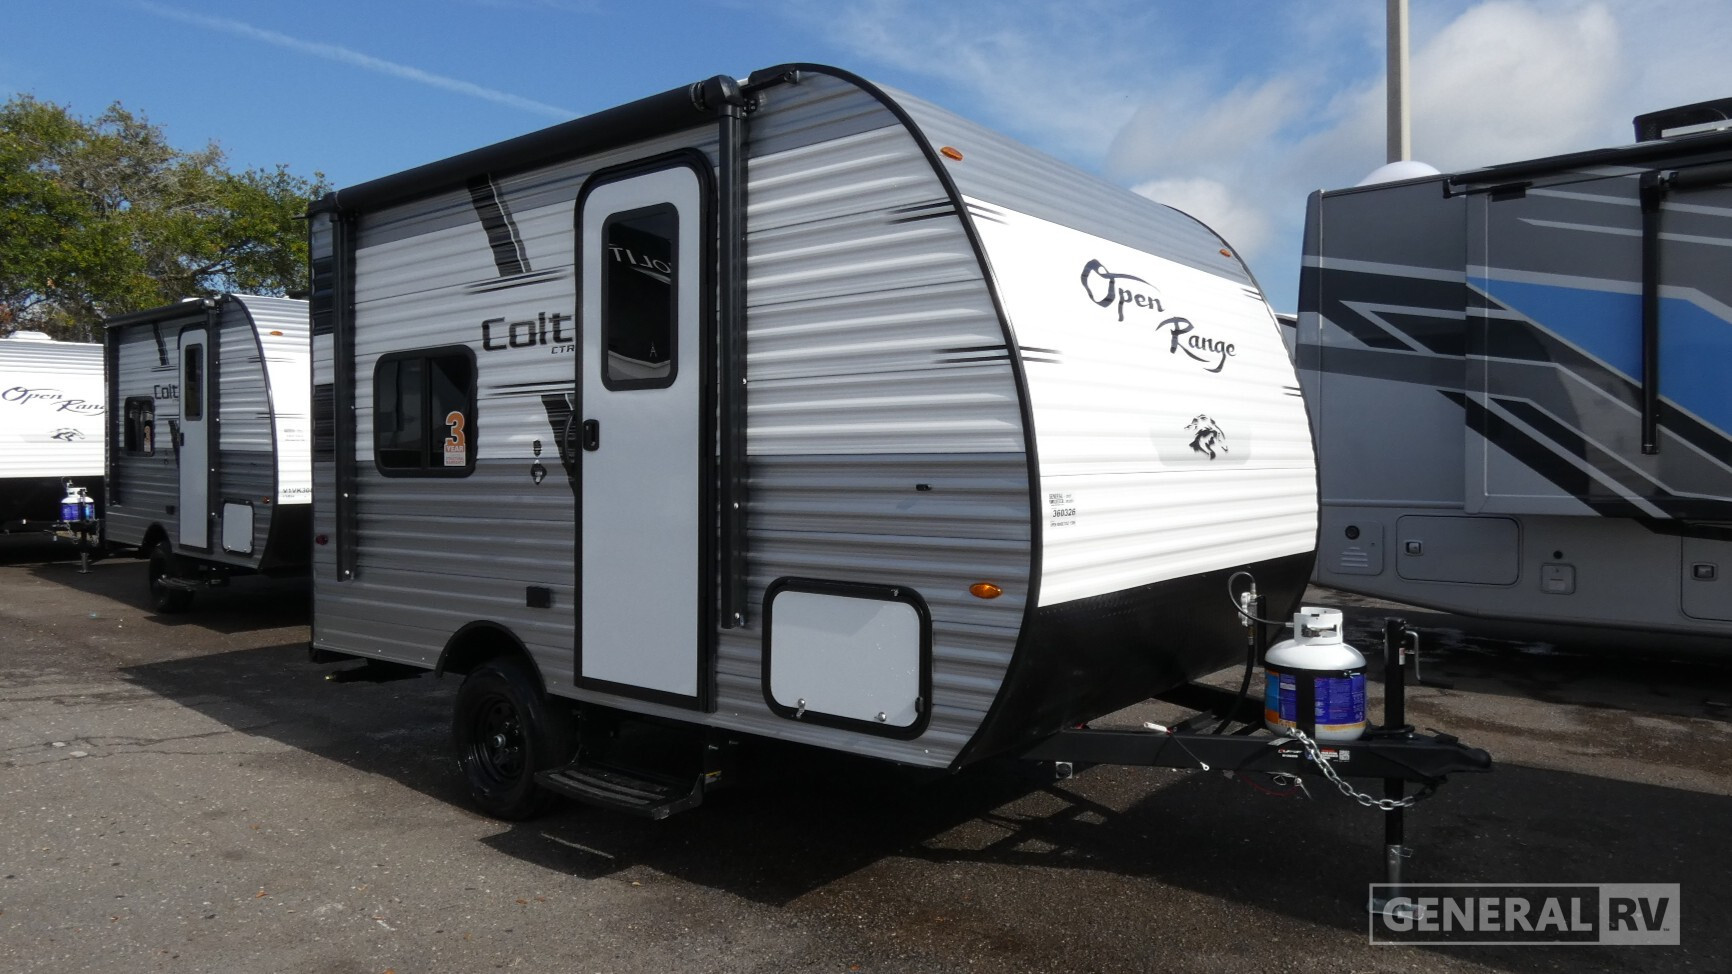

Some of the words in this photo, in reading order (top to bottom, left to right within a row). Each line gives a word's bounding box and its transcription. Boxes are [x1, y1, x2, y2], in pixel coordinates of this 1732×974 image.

[1081, 259, 1165, 322] Open
[481, 311, 574, 352] Colt
[1155, 316, 1237, 373] Range
[551, 344, 575, 355] CTR
[2, 386, 63, 405] Open
[153, 384, 179, 400] Colt
[445, 411, 465, 447] 3
[446, 445, 465, 453] YEAR
